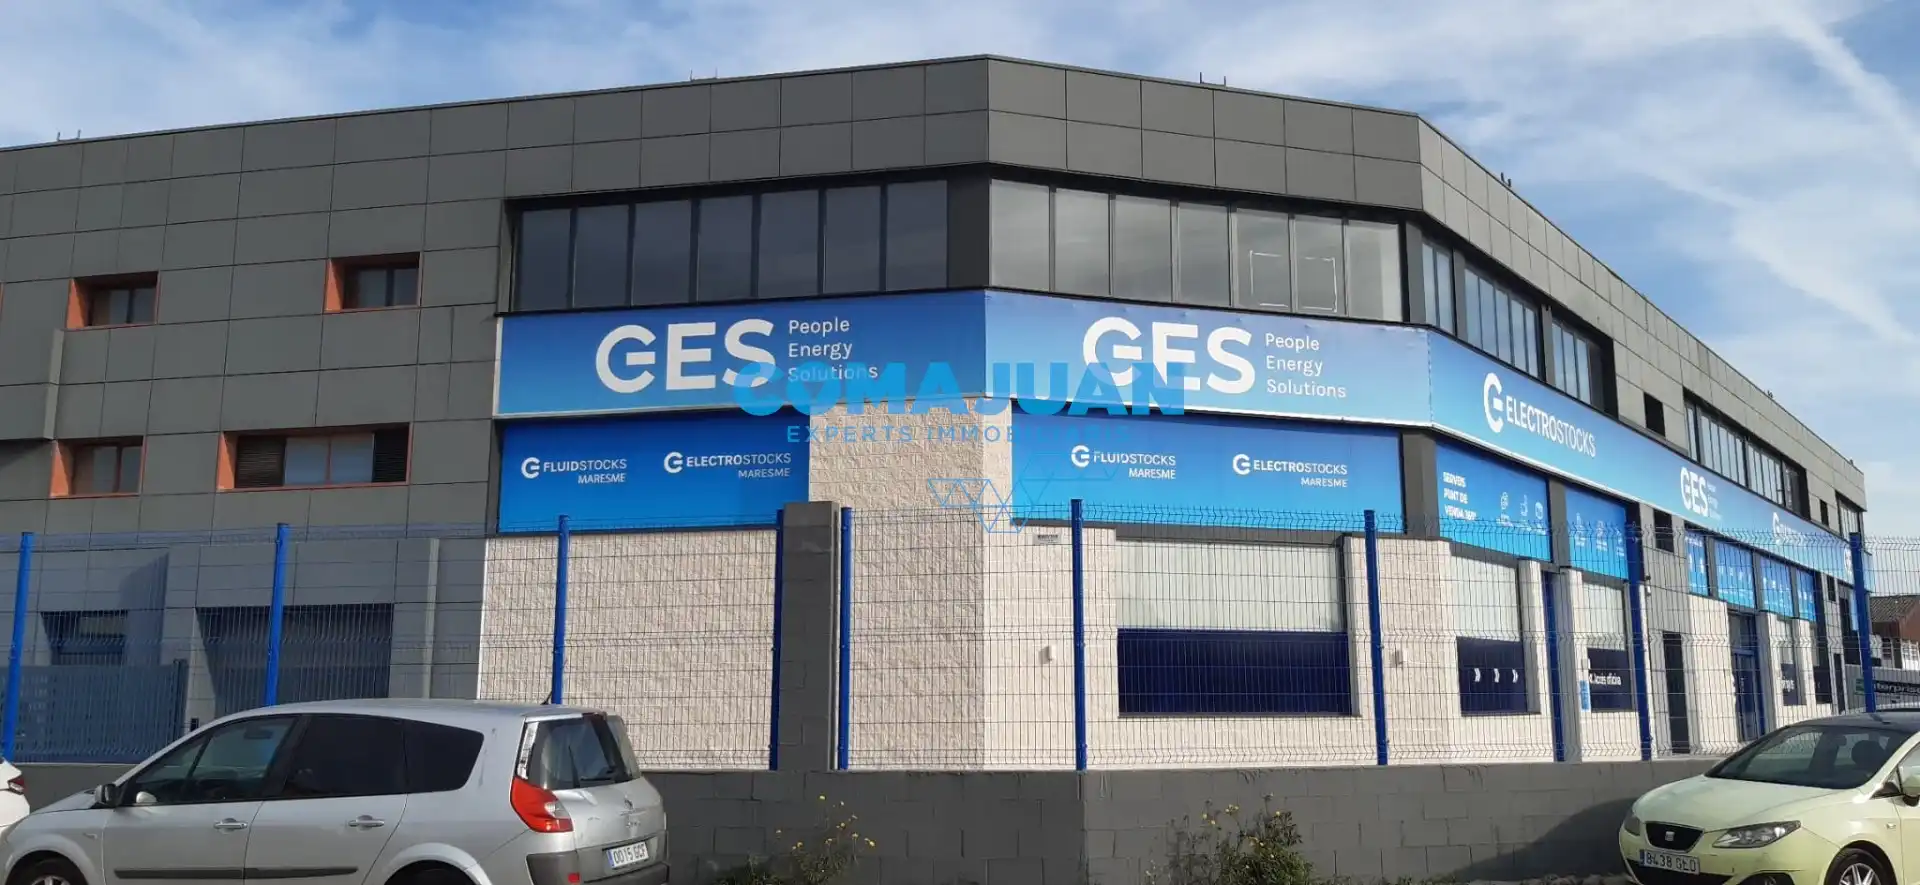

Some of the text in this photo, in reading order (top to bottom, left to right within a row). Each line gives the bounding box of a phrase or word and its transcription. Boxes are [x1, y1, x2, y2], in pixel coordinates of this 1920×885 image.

[788, 316, 850, 338] People
[788, 341, 852, 360] Energy
[1265, 333, 1320, 353] People
[595, 318, 776, 394] GES
[1083, 316, 1256, 394] GES
[788, 364, 878, 383] Solutions
[1266, 355, 1323, 377] Energy
[1267, 379, 1347, 399] Solutions
[1505, 395, 1596, 458] ELECTROSTOCKS
[543, 459, 628, 472] FLUIDSTOCKS
[686, 452, 792, 467] ELECTROSTOCKS
[1093, 450, 1177, 466] FLUIDSTOCKS
[1253, 459, 1349, 475] ELECTROSTOCKS
[577, 473, 627, 484] MARESME
[738, 468, 791, 479] MARESME
[1128, 467, 1177, 480] MARESME
[1300, 476, 1348, 488] MARESME
[1680, 466, 1709, 518] GES
